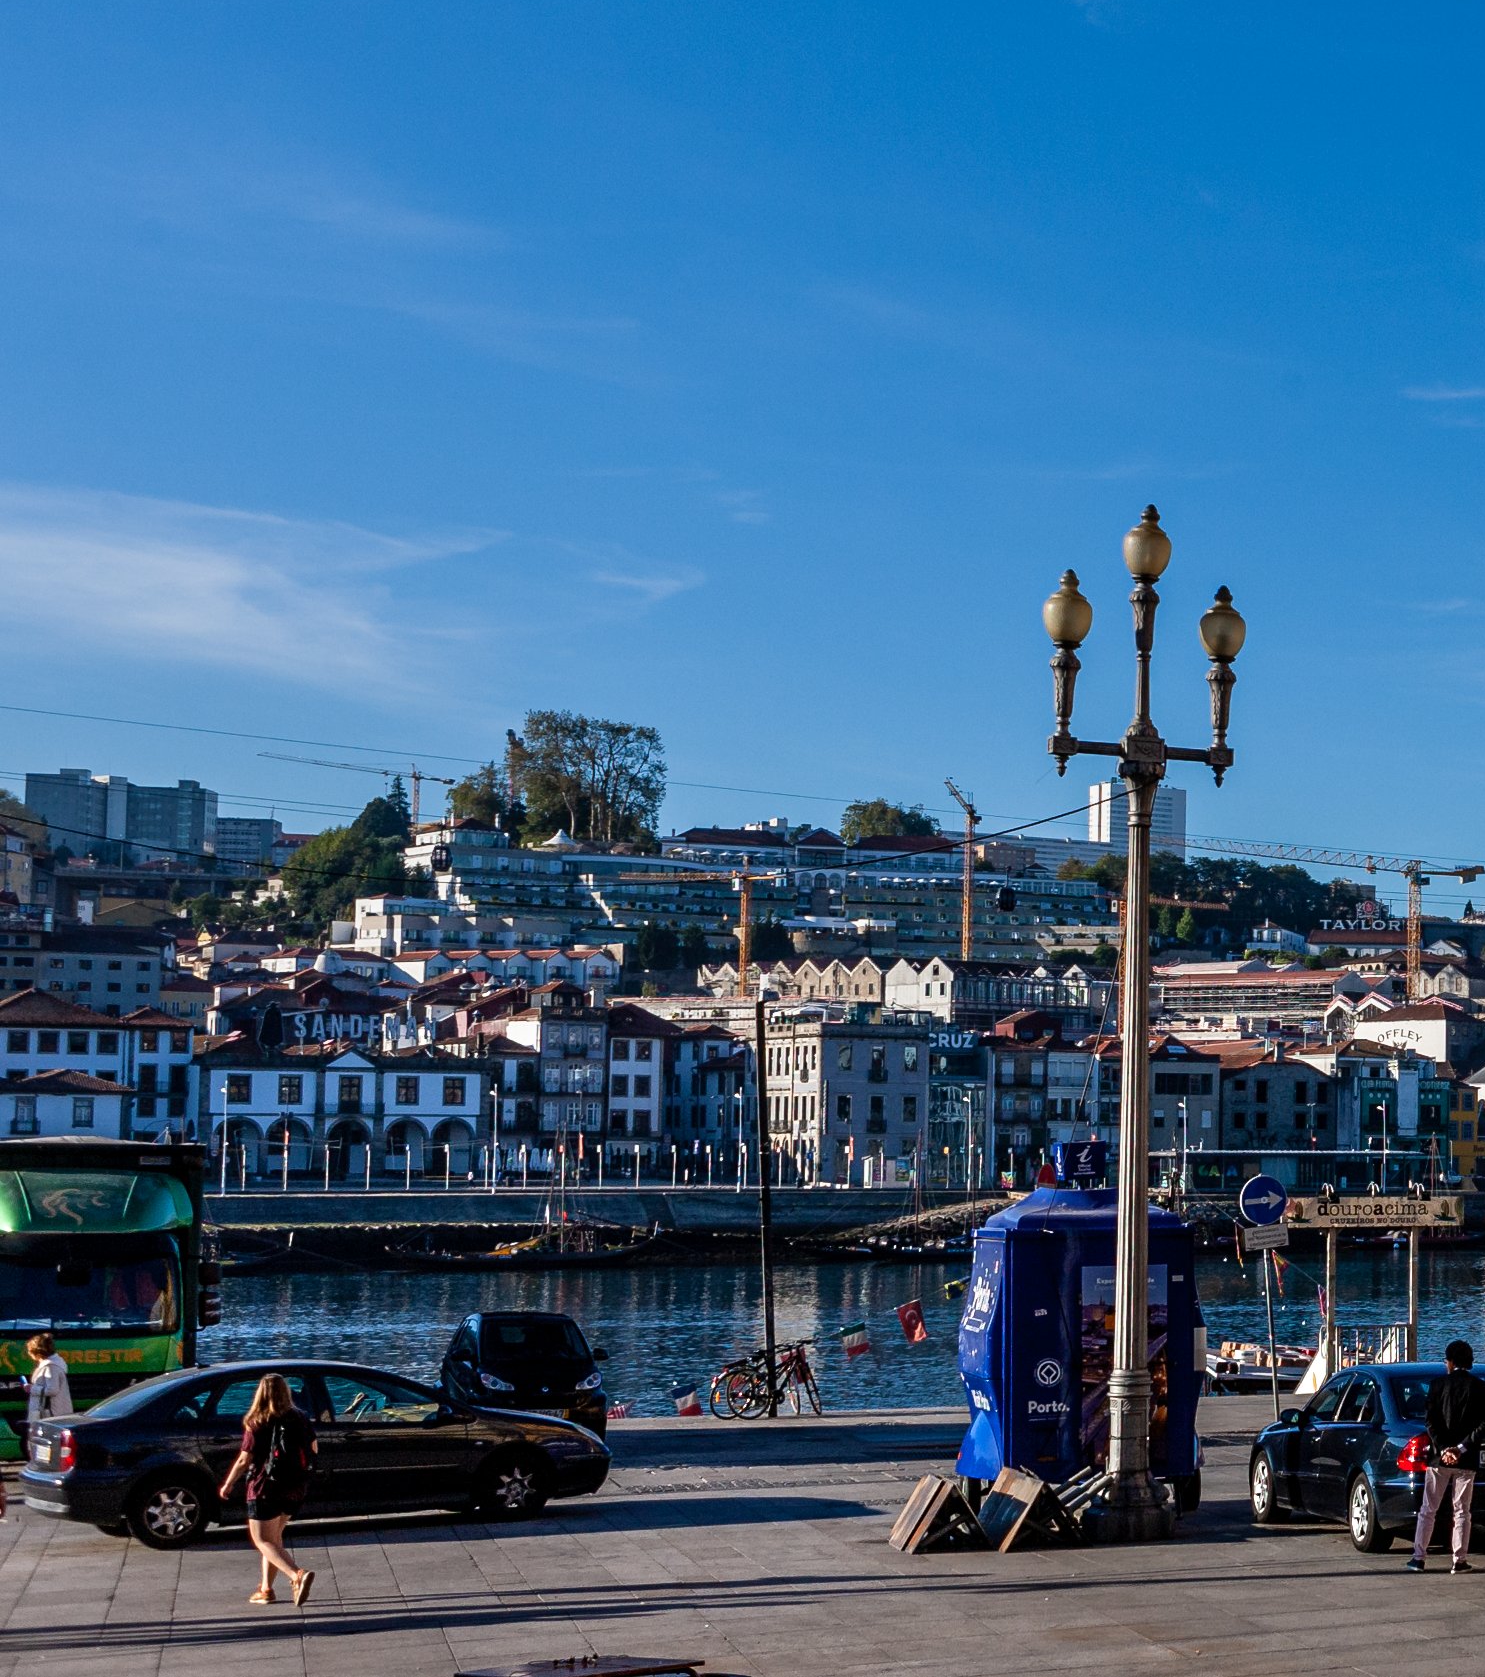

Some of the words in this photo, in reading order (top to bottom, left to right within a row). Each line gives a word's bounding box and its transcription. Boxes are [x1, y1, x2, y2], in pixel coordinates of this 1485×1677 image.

[294, 1014, 437, 1040] SANDEMAN
[928, 1032, 974, 1048] CRUZ
[1377, 1028, 1423, 1043] OFFLEY
[1317, 1201, 1429, 1216] douroacima
